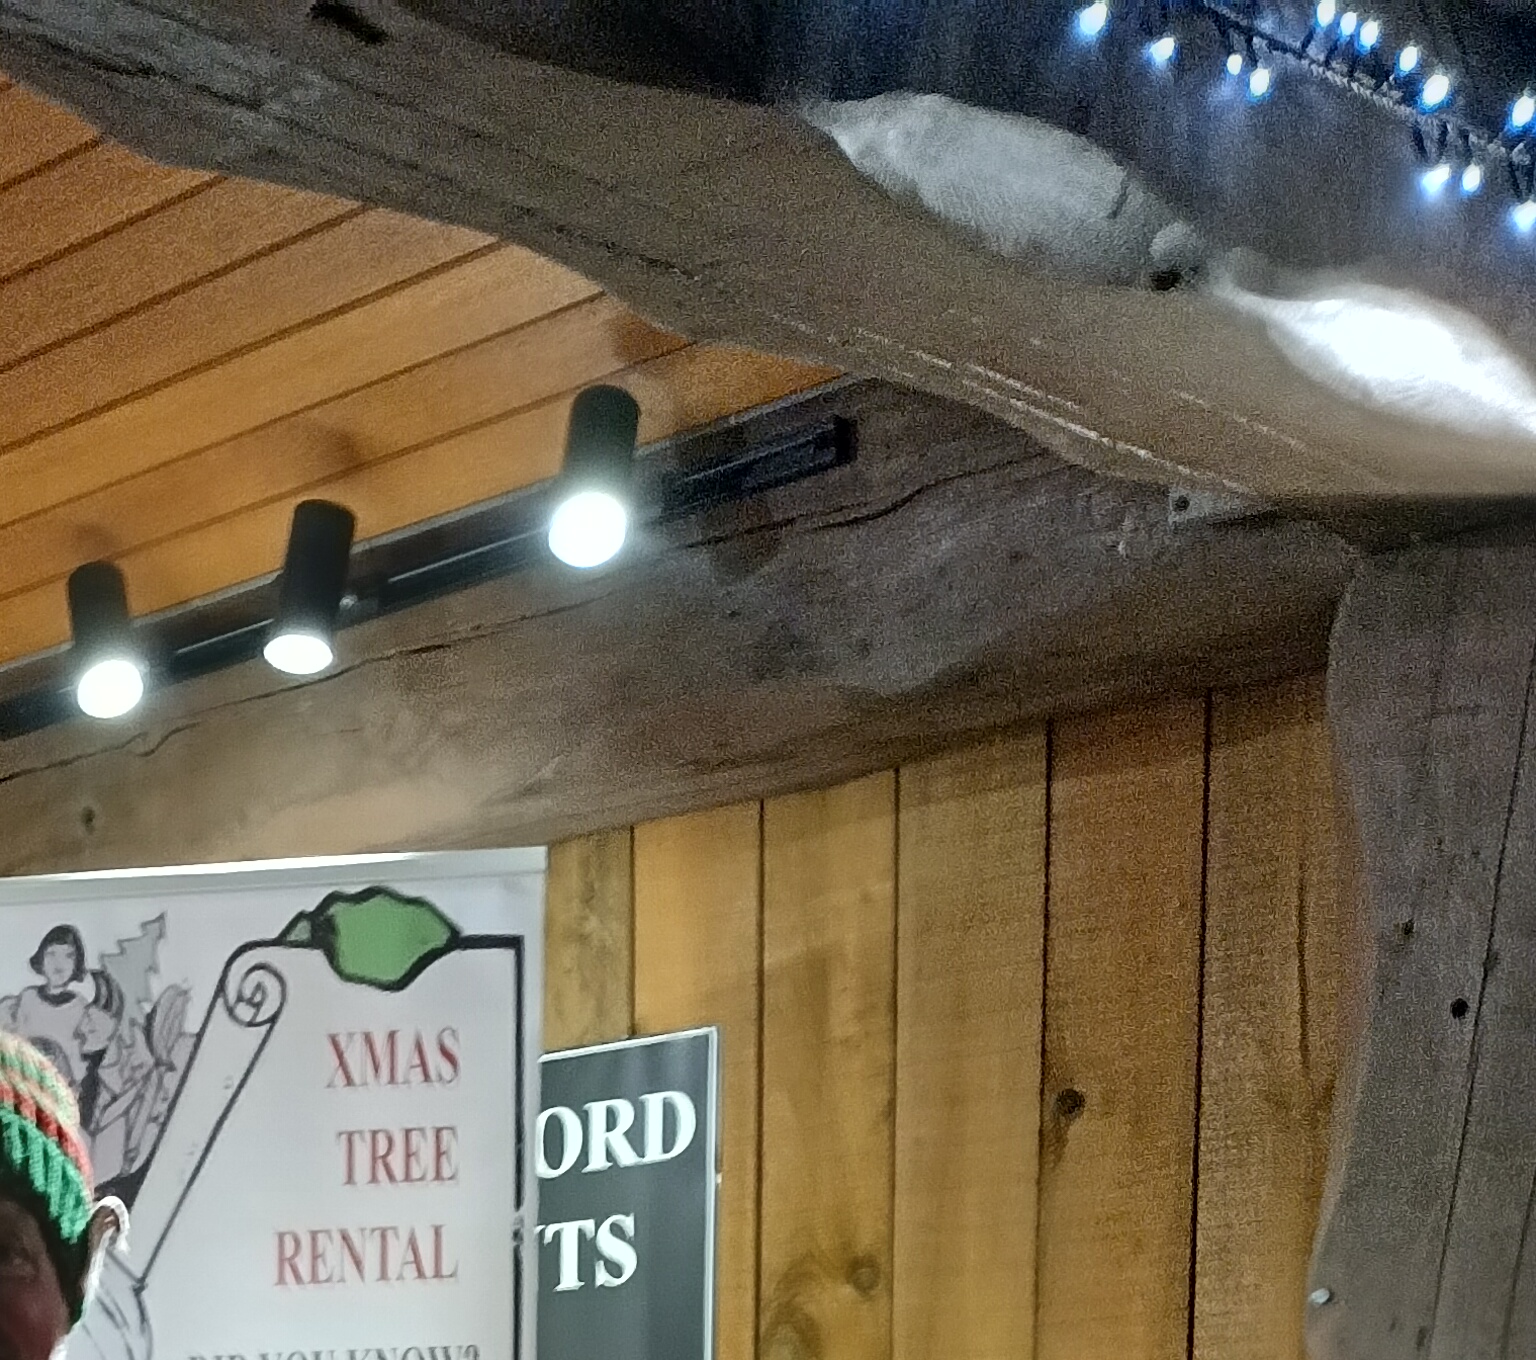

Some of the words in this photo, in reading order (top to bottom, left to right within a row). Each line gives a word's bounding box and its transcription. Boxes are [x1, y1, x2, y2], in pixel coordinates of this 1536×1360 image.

[325, 1026, 461, 1089] XMAS
[337, 1126, 459, 1186] TREE
[535, 1090, 697, 1179] ORD
[274, 1224, 459, 1287] RENTAL
[534, 1212, 638, 1292] TS
